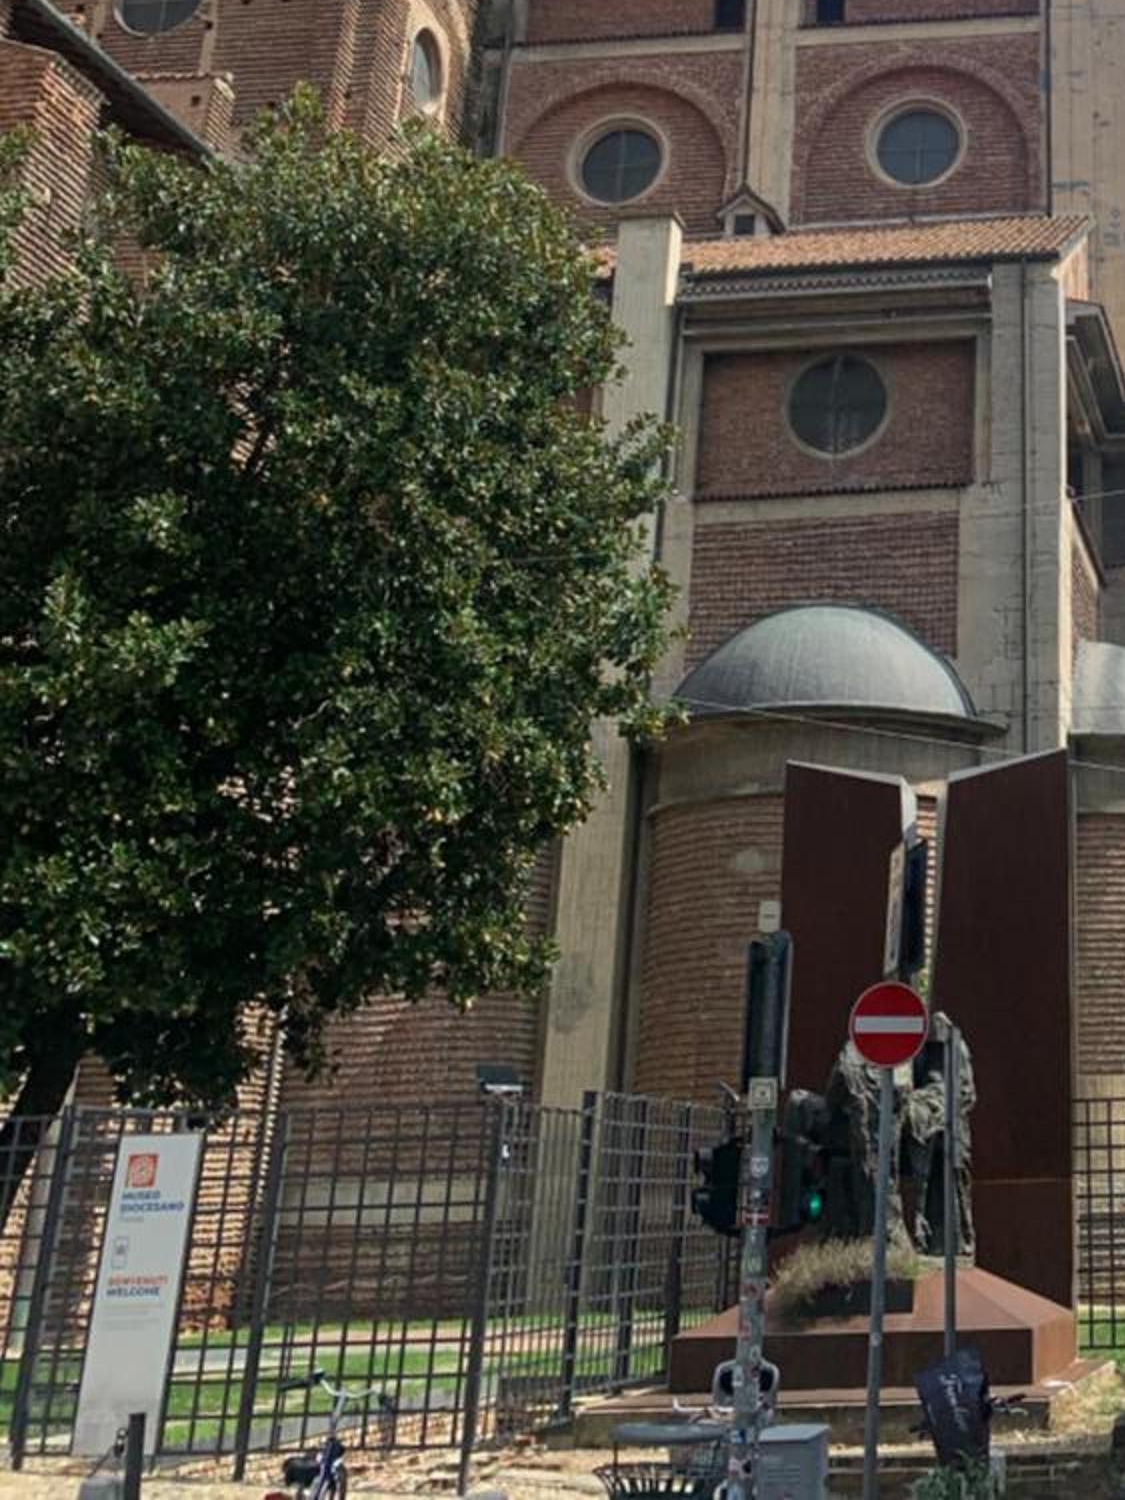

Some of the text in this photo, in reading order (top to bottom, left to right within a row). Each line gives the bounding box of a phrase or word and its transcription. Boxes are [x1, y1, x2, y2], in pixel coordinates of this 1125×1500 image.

[121, 1190, 161, 1200] MUSEO
[120, 1201, 184, 1212] DIOCESANO
[106, 1287, 160, 1297] WELCOME
